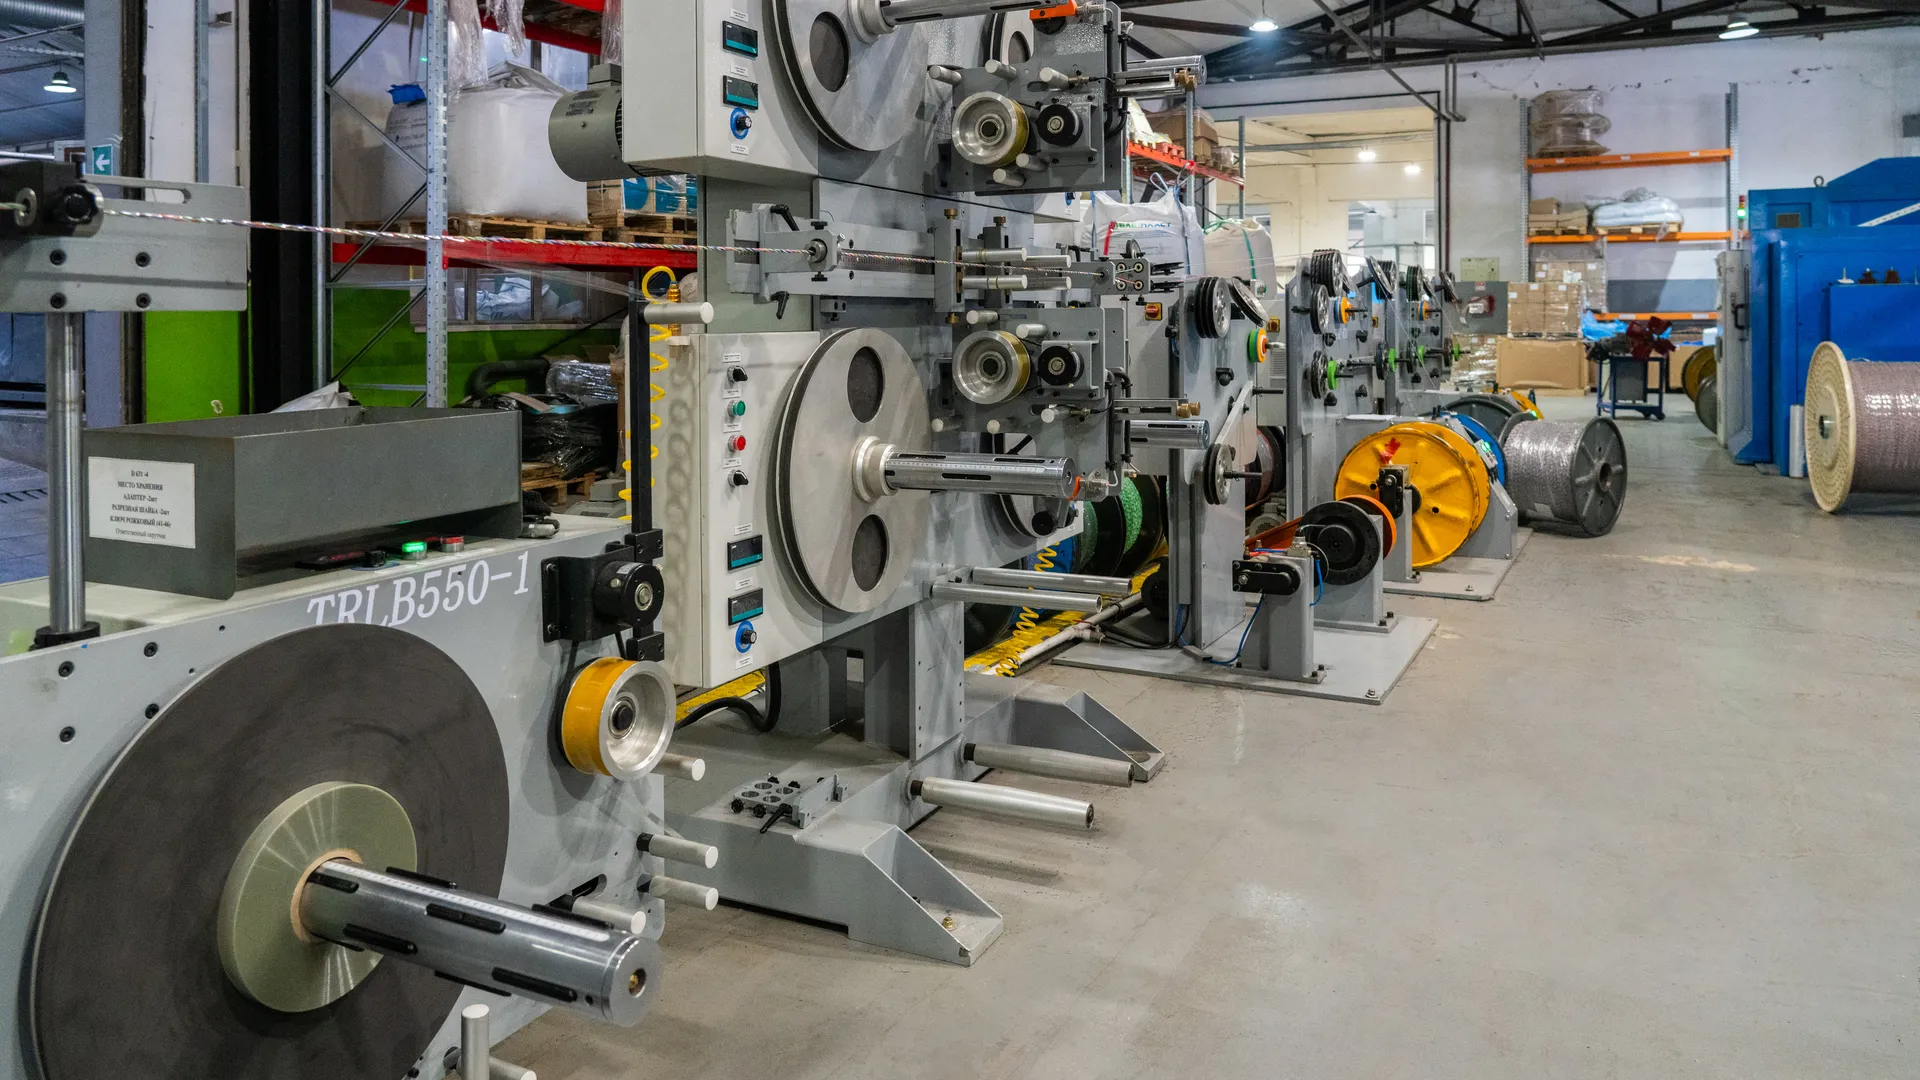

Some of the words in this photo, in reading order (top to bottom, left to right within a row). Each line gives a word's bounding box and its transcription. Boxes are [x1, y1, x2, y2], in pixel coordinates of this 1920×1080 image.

[136, 482, 163, 491] ХРАНЕНИЯ
[123, 493, 146, 501] АДАПТЕР
[112, 504, 139, 512] РАЗРЕЗНАЯ
[139, 506, 158, 515] ШАЙБА
[110, 515, 125, 523] КЛЮЧ
[125, 516, 155, 526] РОЖКОВЫЙ
[115, 528, 147, 537] Ответственный
